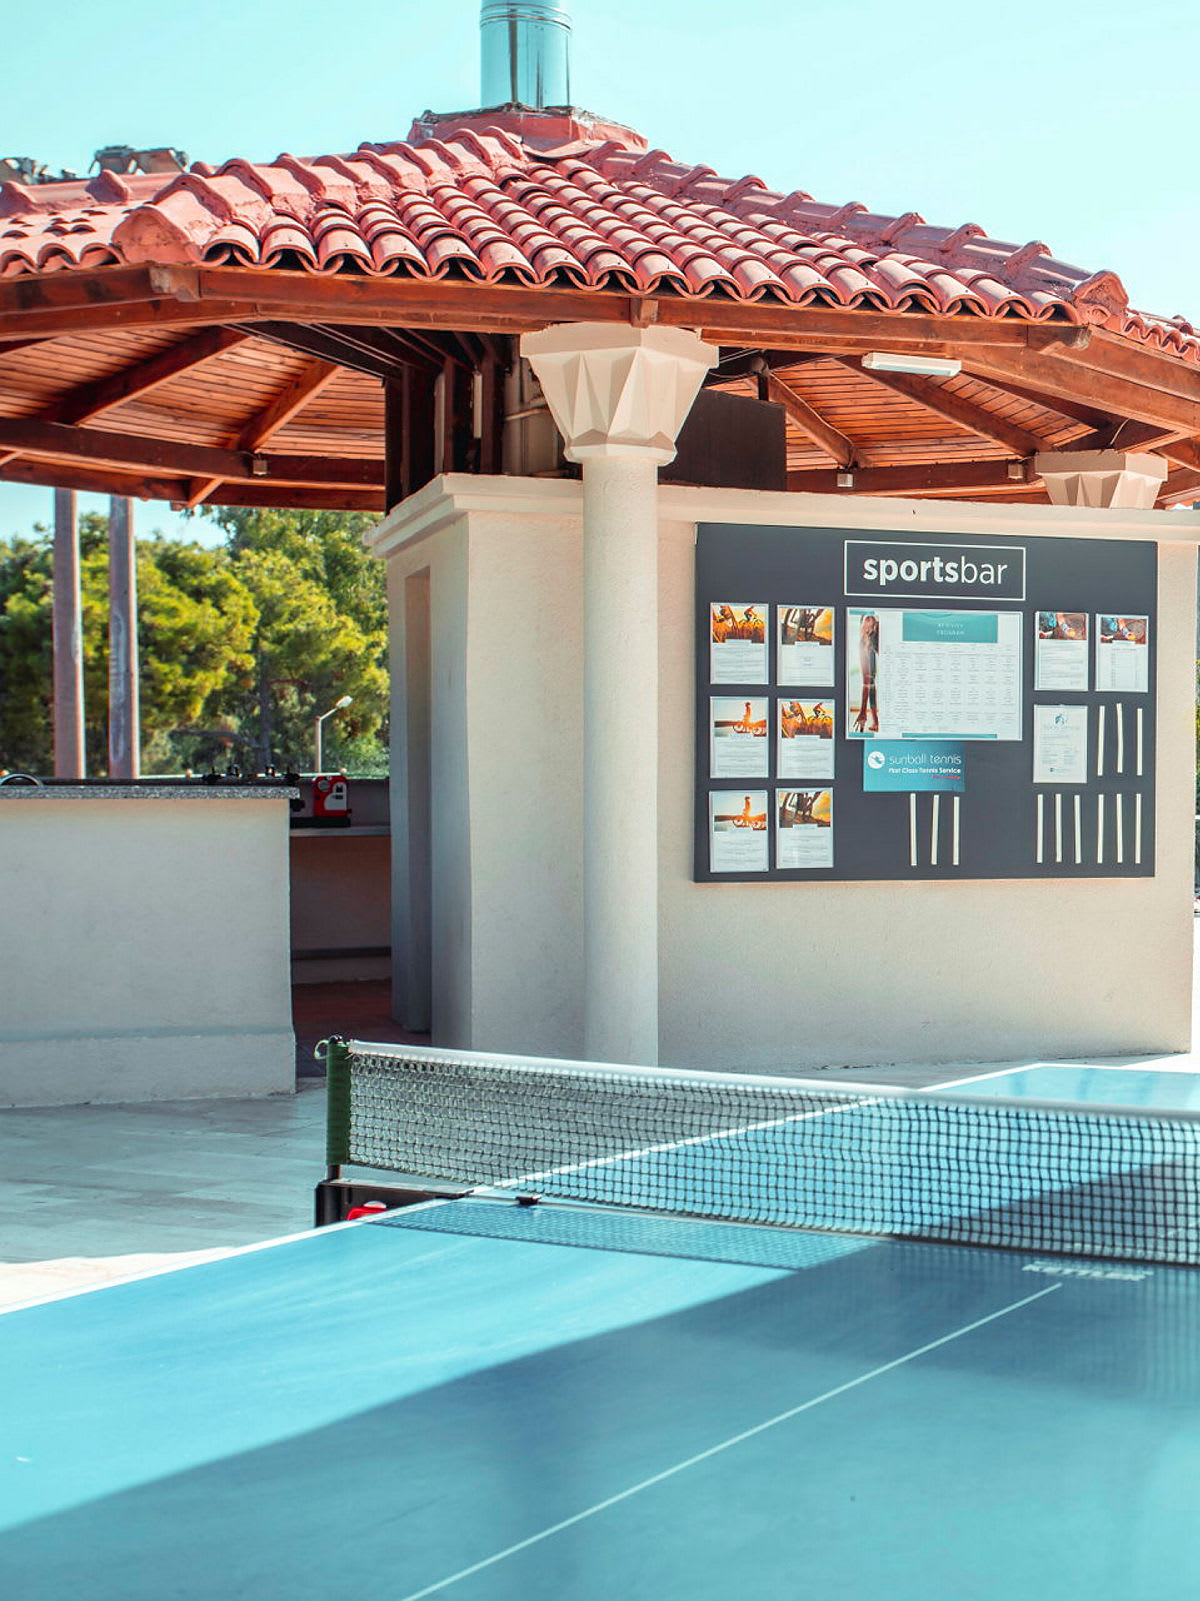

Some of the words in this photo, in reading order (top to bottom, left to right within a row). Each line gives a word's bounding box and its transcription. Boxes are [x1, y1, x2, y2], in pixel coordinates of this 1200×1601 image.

[863, 555, 1008, 586] sportsbar
[889, 752, 927, 765] sunball
[930, 753, 962, 765] tennis
